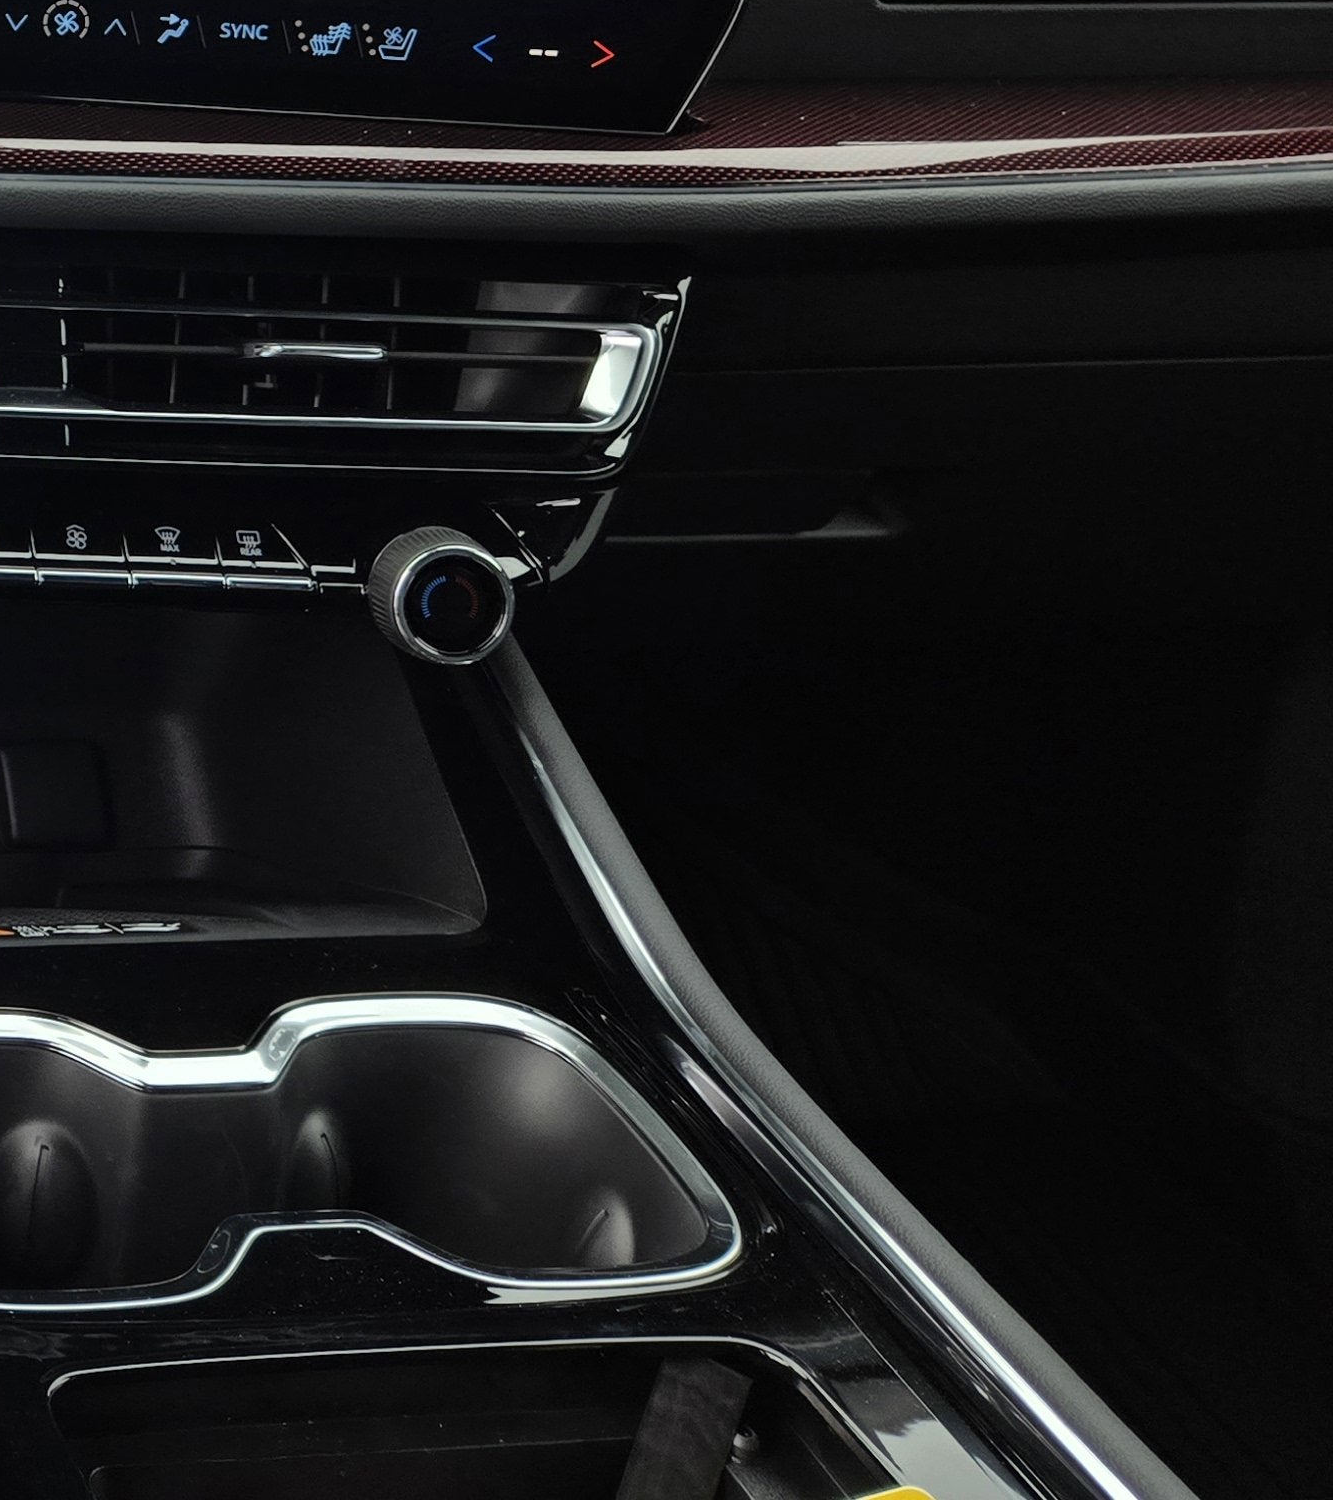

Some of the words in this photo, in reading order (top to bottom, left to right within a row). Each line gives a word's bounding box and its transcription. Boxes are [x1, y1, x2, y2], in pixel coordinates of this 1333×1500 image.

[219, 22, 269, 41] SYNC
[159, 543, 181, 553] MAX
[239, 547, 263, 557] REAR
